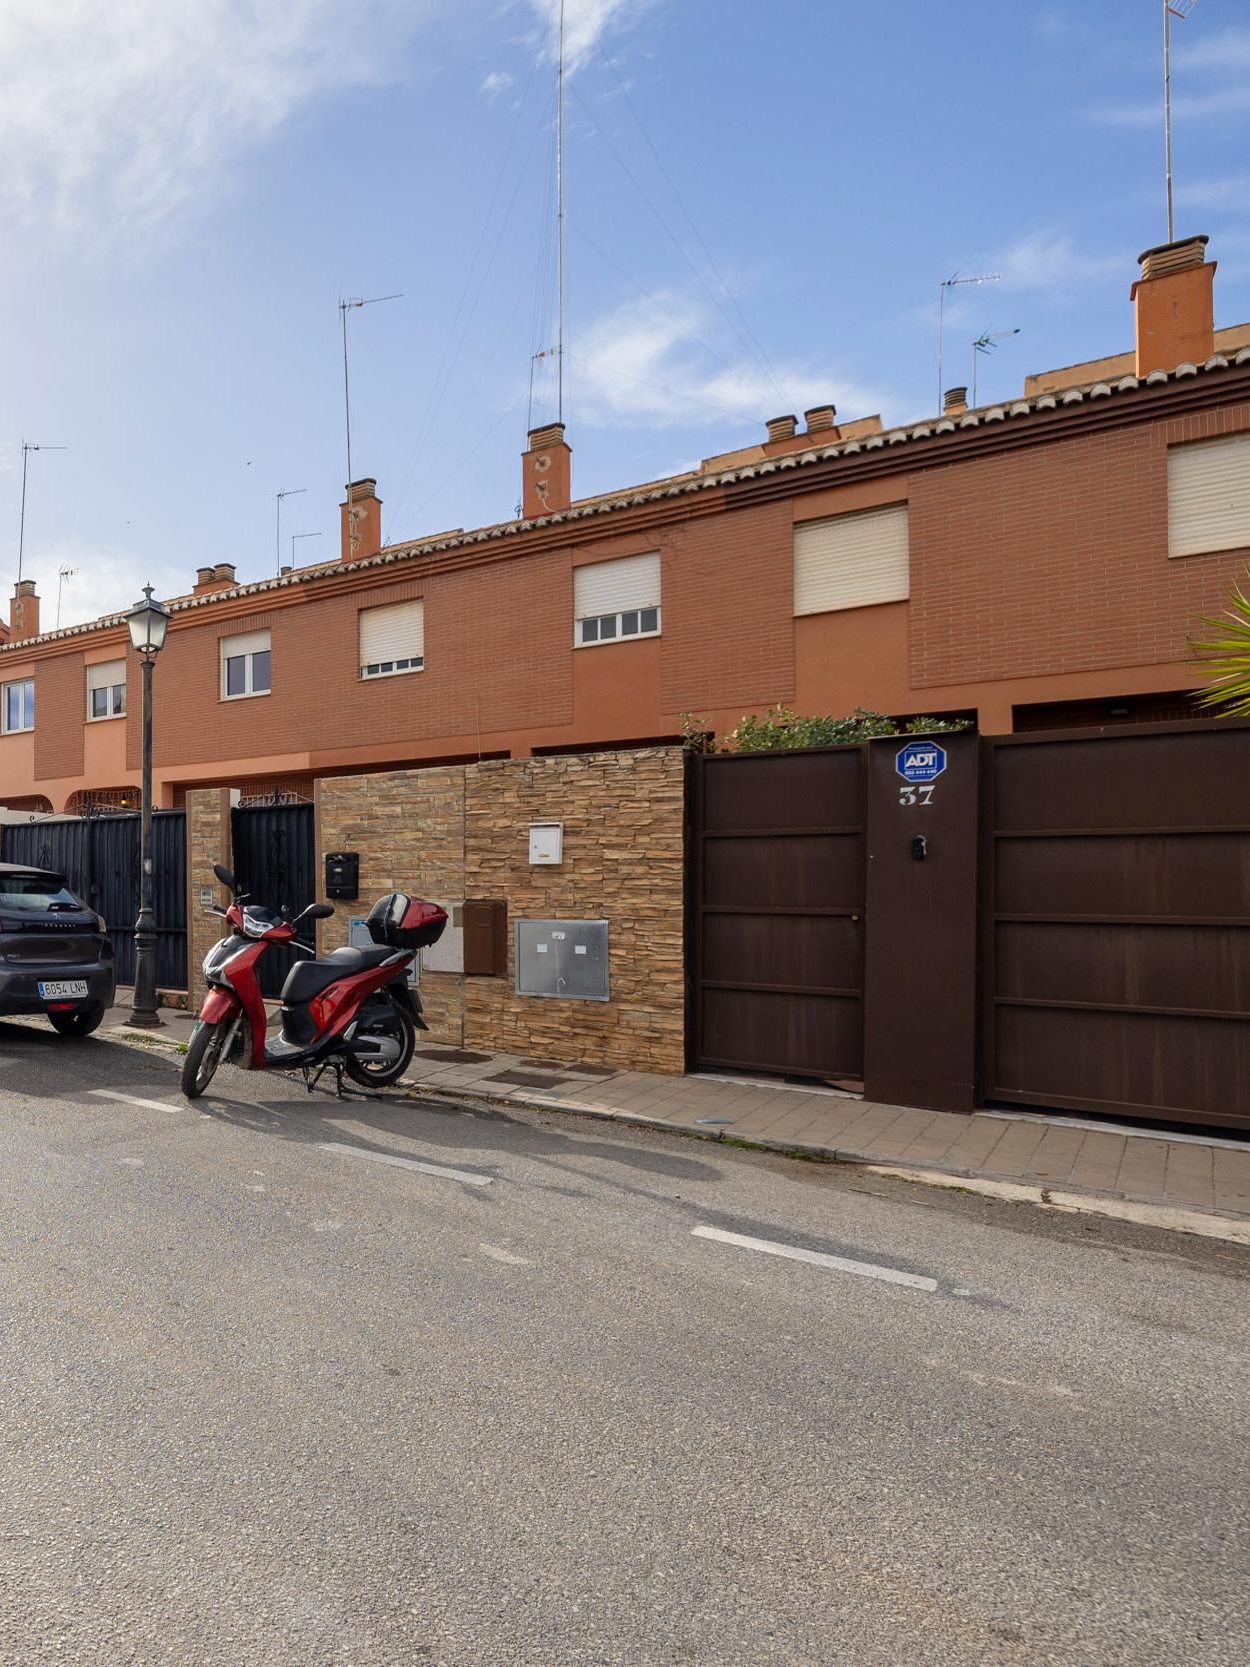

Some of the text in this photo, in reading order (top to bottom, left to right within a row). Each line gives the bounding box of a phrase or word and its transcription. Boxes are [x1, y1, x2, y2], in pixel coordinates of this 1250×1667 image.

[905, 753, 937, 767] ADT
[899, 785, 935, 805] 37
[45, 982, 87, 995] 6054 LNH
